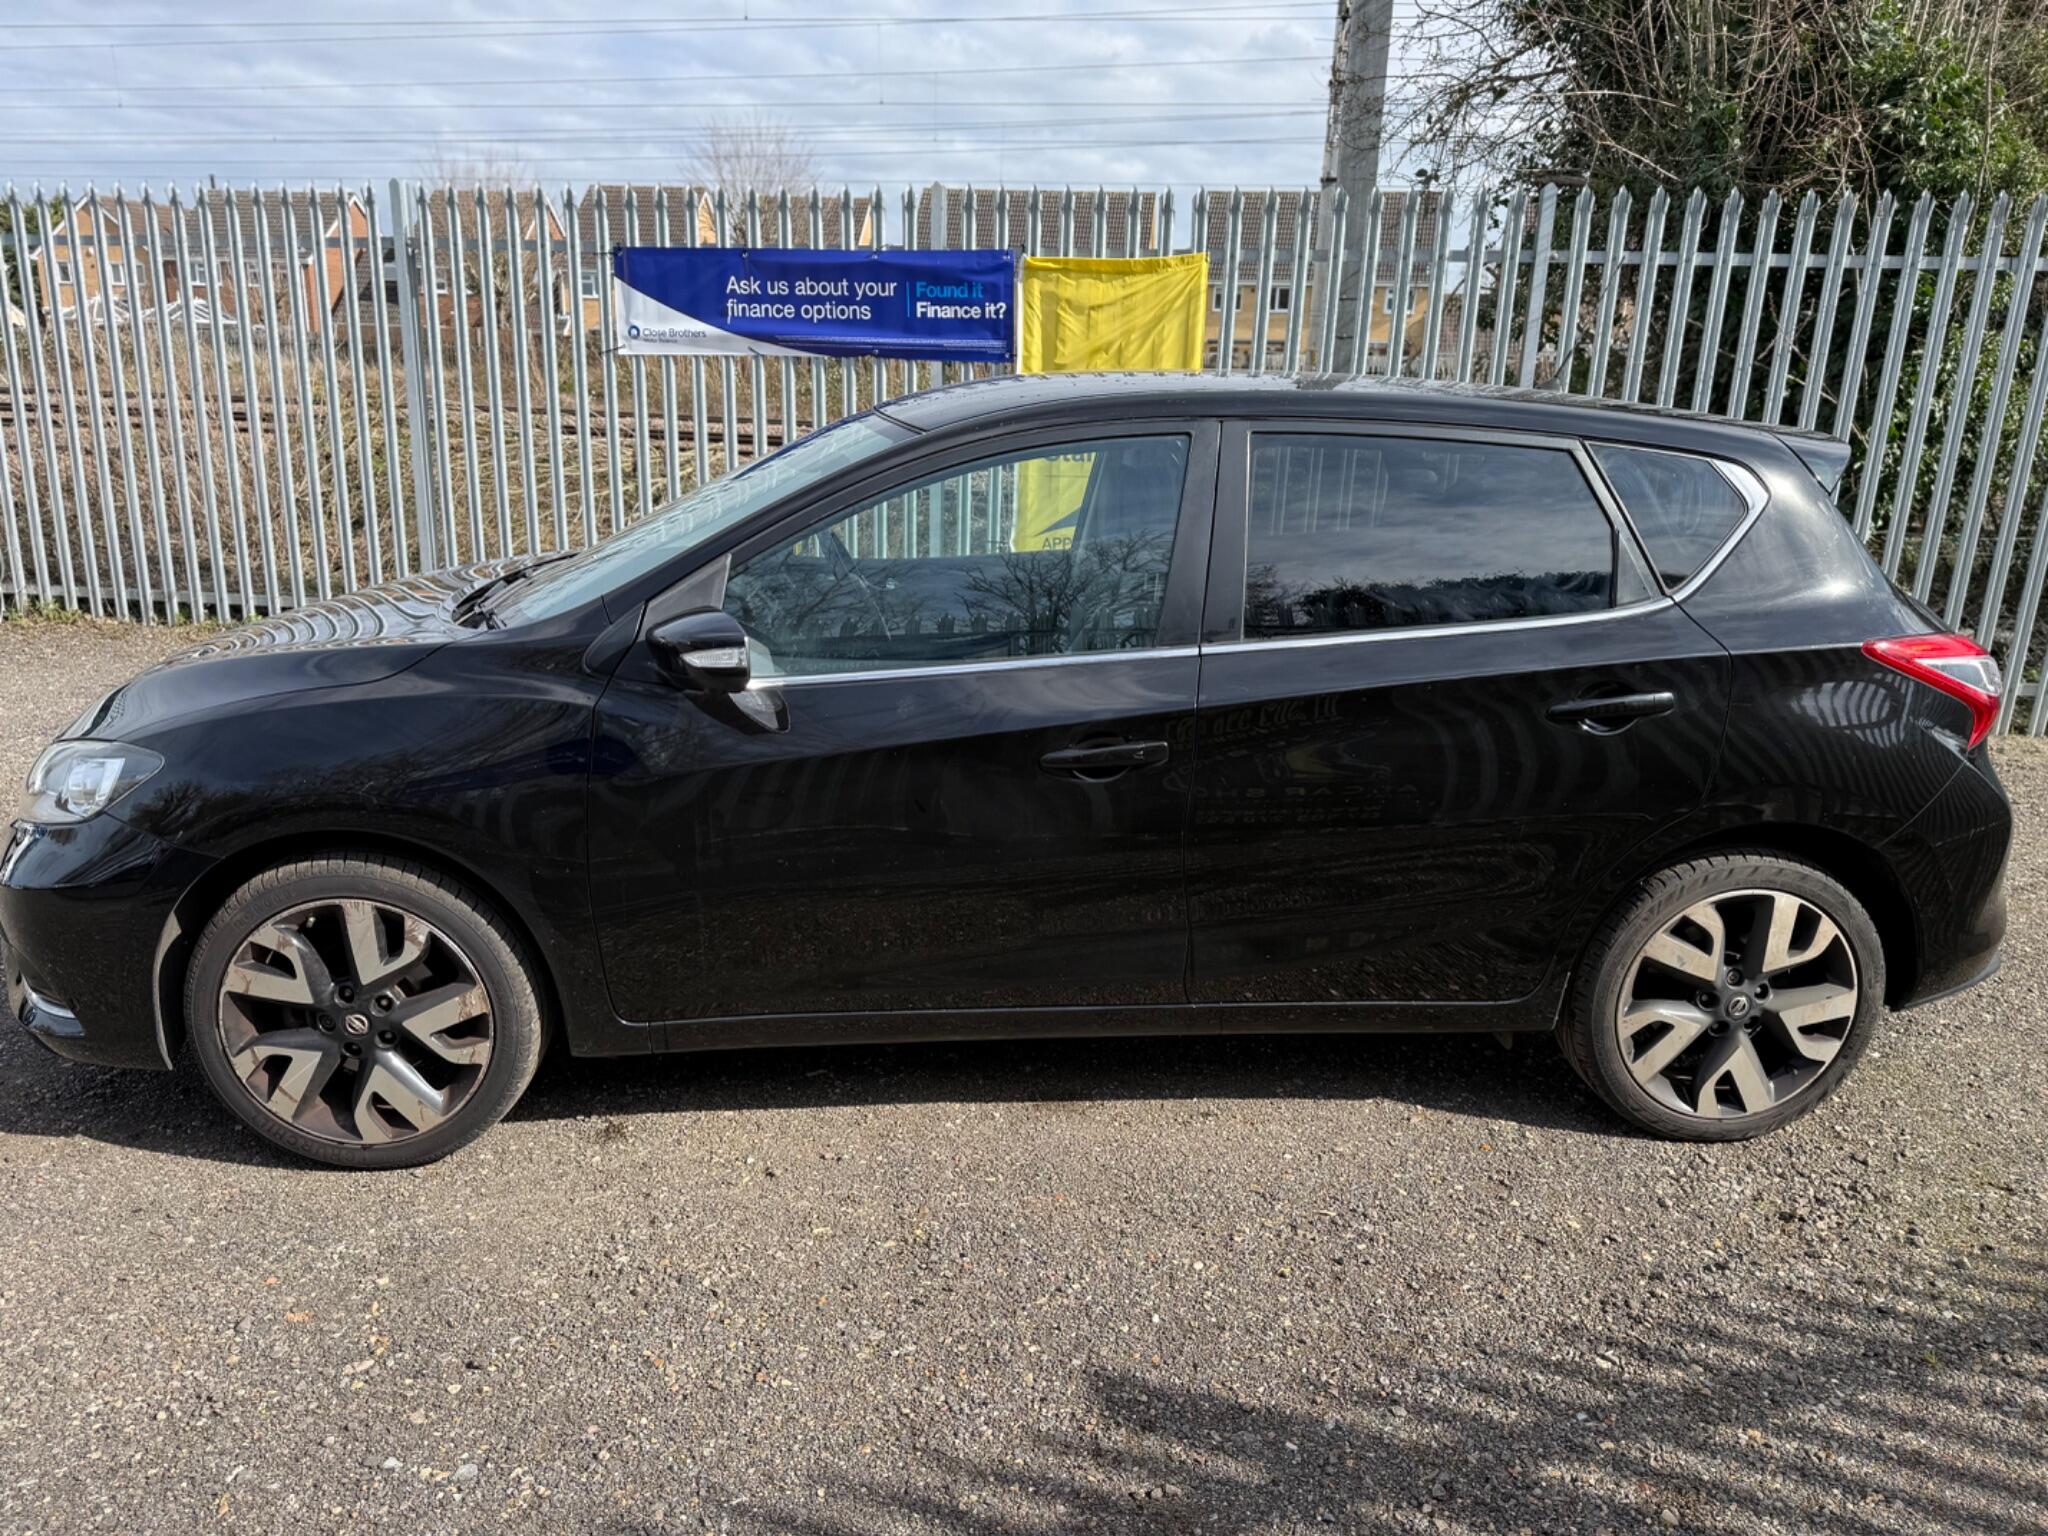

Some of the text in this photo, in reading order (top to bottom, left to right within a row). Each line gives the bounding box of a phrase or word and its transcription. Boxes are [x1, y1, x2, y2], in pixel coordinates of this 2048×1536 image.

[726, 275, 897, 300] Ask us about your
[916, 281, 984, 298] Found it
[726, 299, 871, 324] finance options
[916, 302, 1007, 319] Finance it?
[669, 328, 707, 338] Brothers
